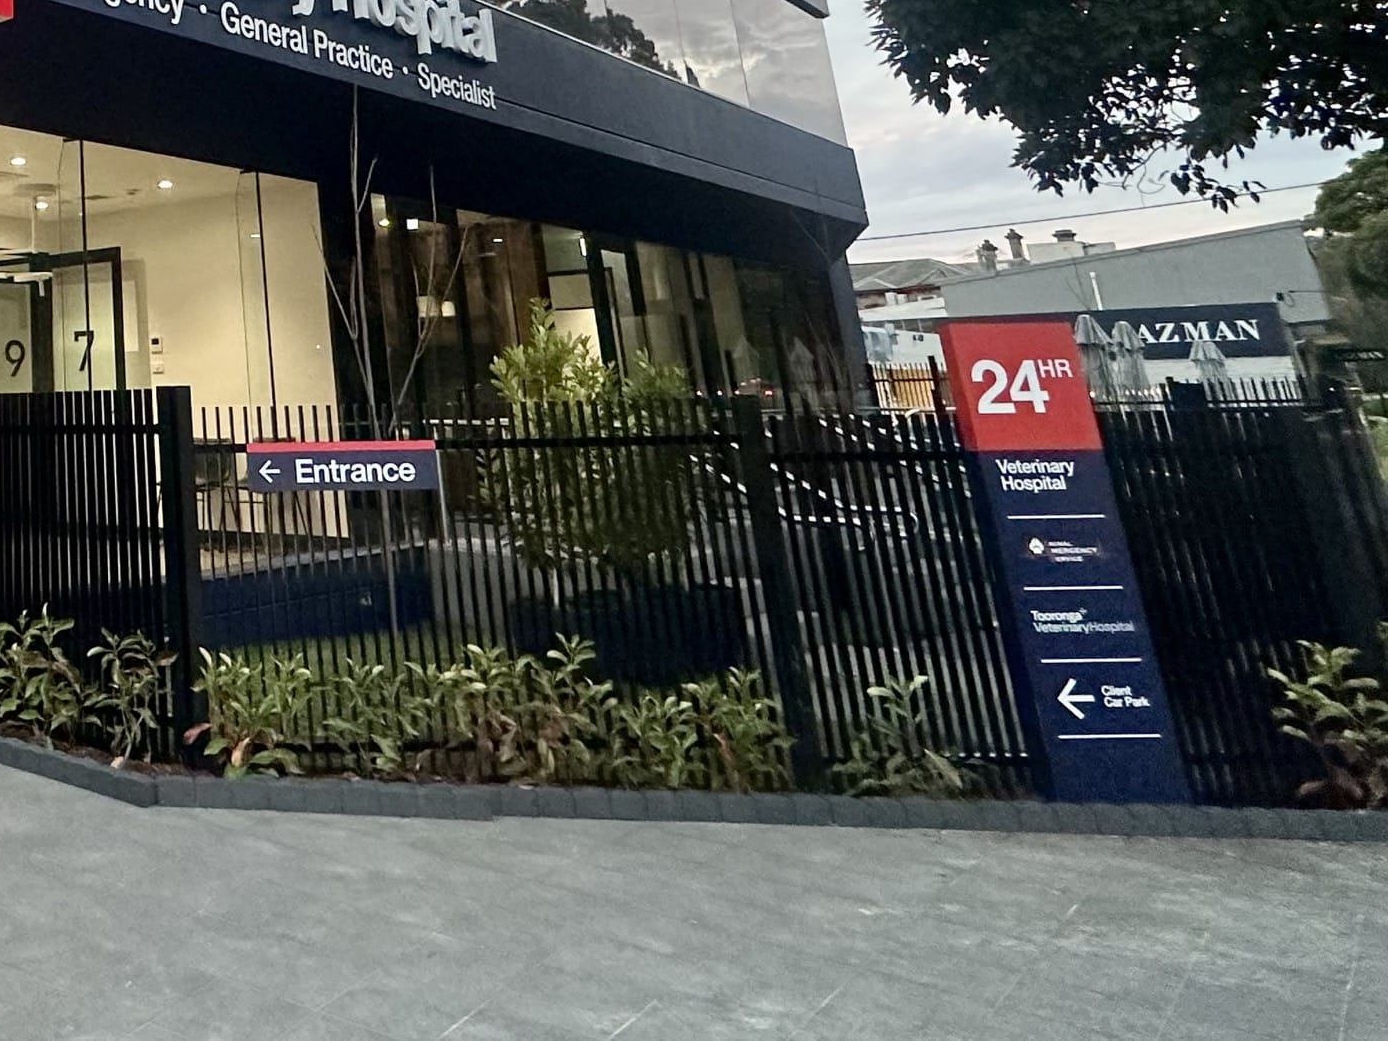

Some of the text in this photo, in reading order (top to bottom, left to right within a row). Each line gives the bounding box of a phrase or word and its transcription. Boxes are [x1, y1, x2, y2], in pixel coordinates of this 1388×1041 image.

[220, 1, 309, 55] General
[313, 29, 394, 80] Practice
[417, 64, 498, 112] Specialist
[1137, 319, 1261, 343] AZMAN
[5, 331, 95, 378] 9 7
[971, 359, 1073, 414] 24 HR
[294, 458, 416, 485] Entrance
[995, 458, 1075, 478] Veterinary
[1000, 474, 1067, 494] Hospital
[1030, 610, 1083, 623] Tooronga
[1101, 685, 1132, 697] Client
[1104, 695, 1151, 708] Car Park
